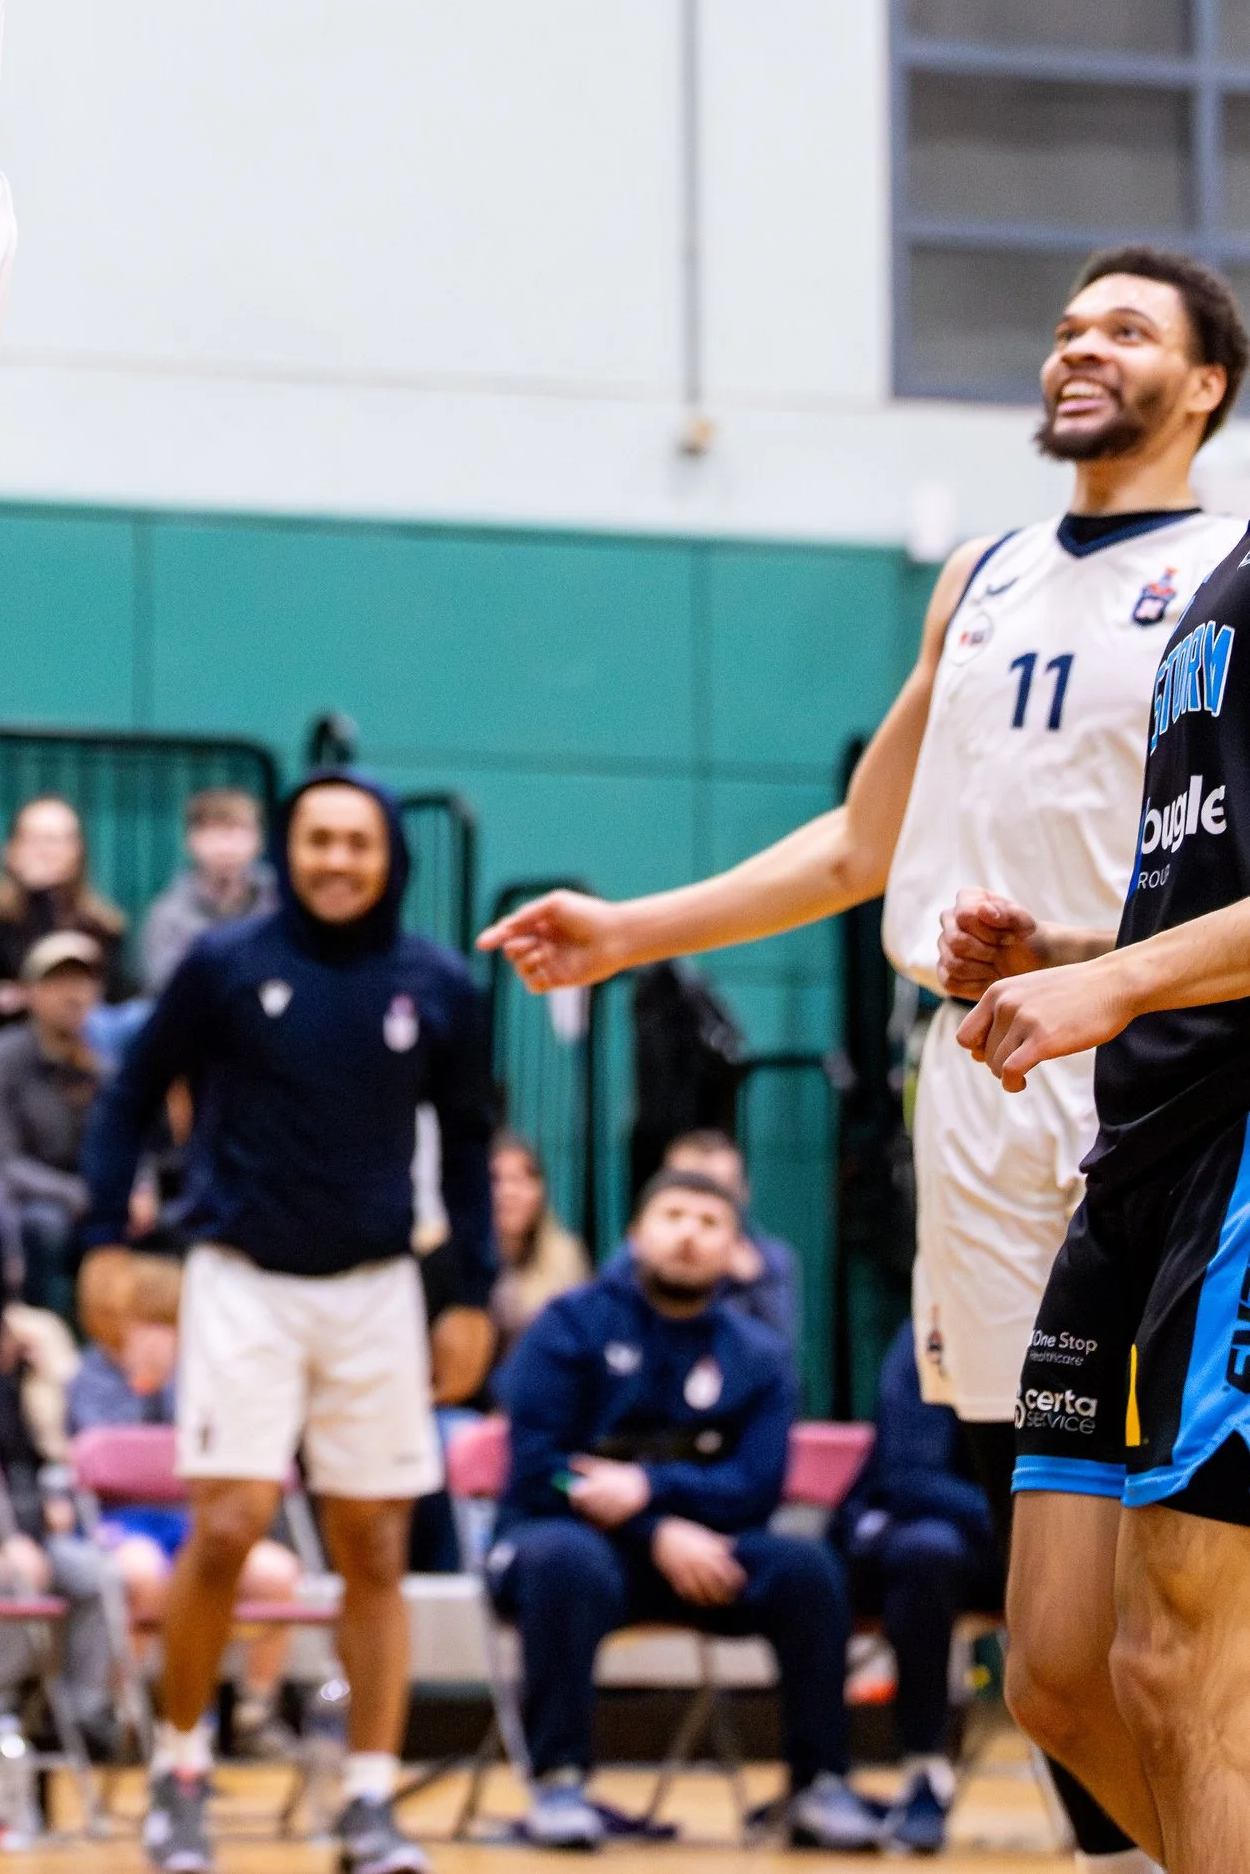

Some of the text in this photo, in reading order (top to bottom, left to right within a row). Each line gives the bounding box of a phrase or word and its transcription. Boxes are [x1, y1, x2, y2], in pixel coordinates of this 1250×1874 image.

[1008, 647, 1075, 731] 11
[1031, 1329, 1097, 1354] One Stop
[1025, 1389, 1097, 1417] certa
